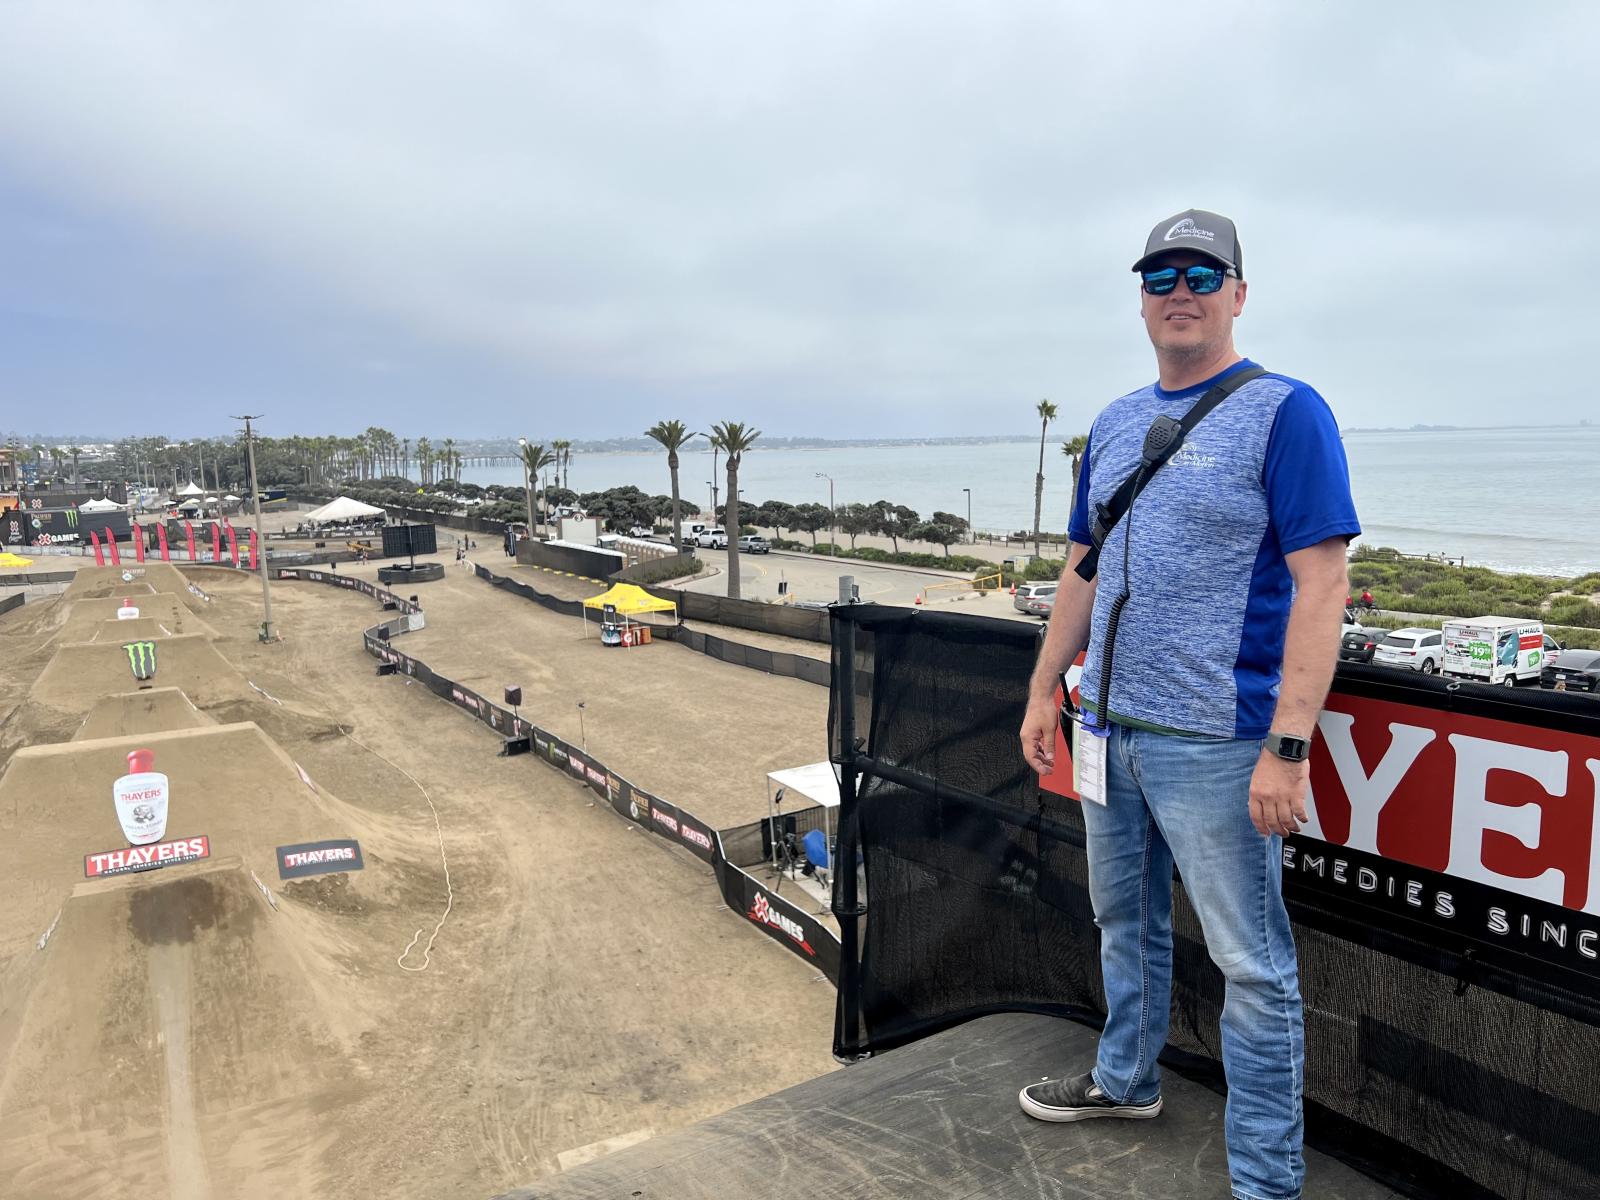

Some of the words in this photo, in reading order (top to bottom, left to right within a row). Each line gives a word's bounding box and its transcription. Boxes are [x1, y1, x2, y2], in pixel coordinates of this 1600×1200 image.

[1175, 226, 1214, 237] Medicine
[121, 788, 161, 801] THAYERS
[91, 838, 204, 873] THAYERS
[287, 847, 354, 867] THAYERS
[1282, 845, 1456, 918] EMEDIES
[1486, 906, 1600, 959] SINC
[768, 907, 805, 942] GAMES
